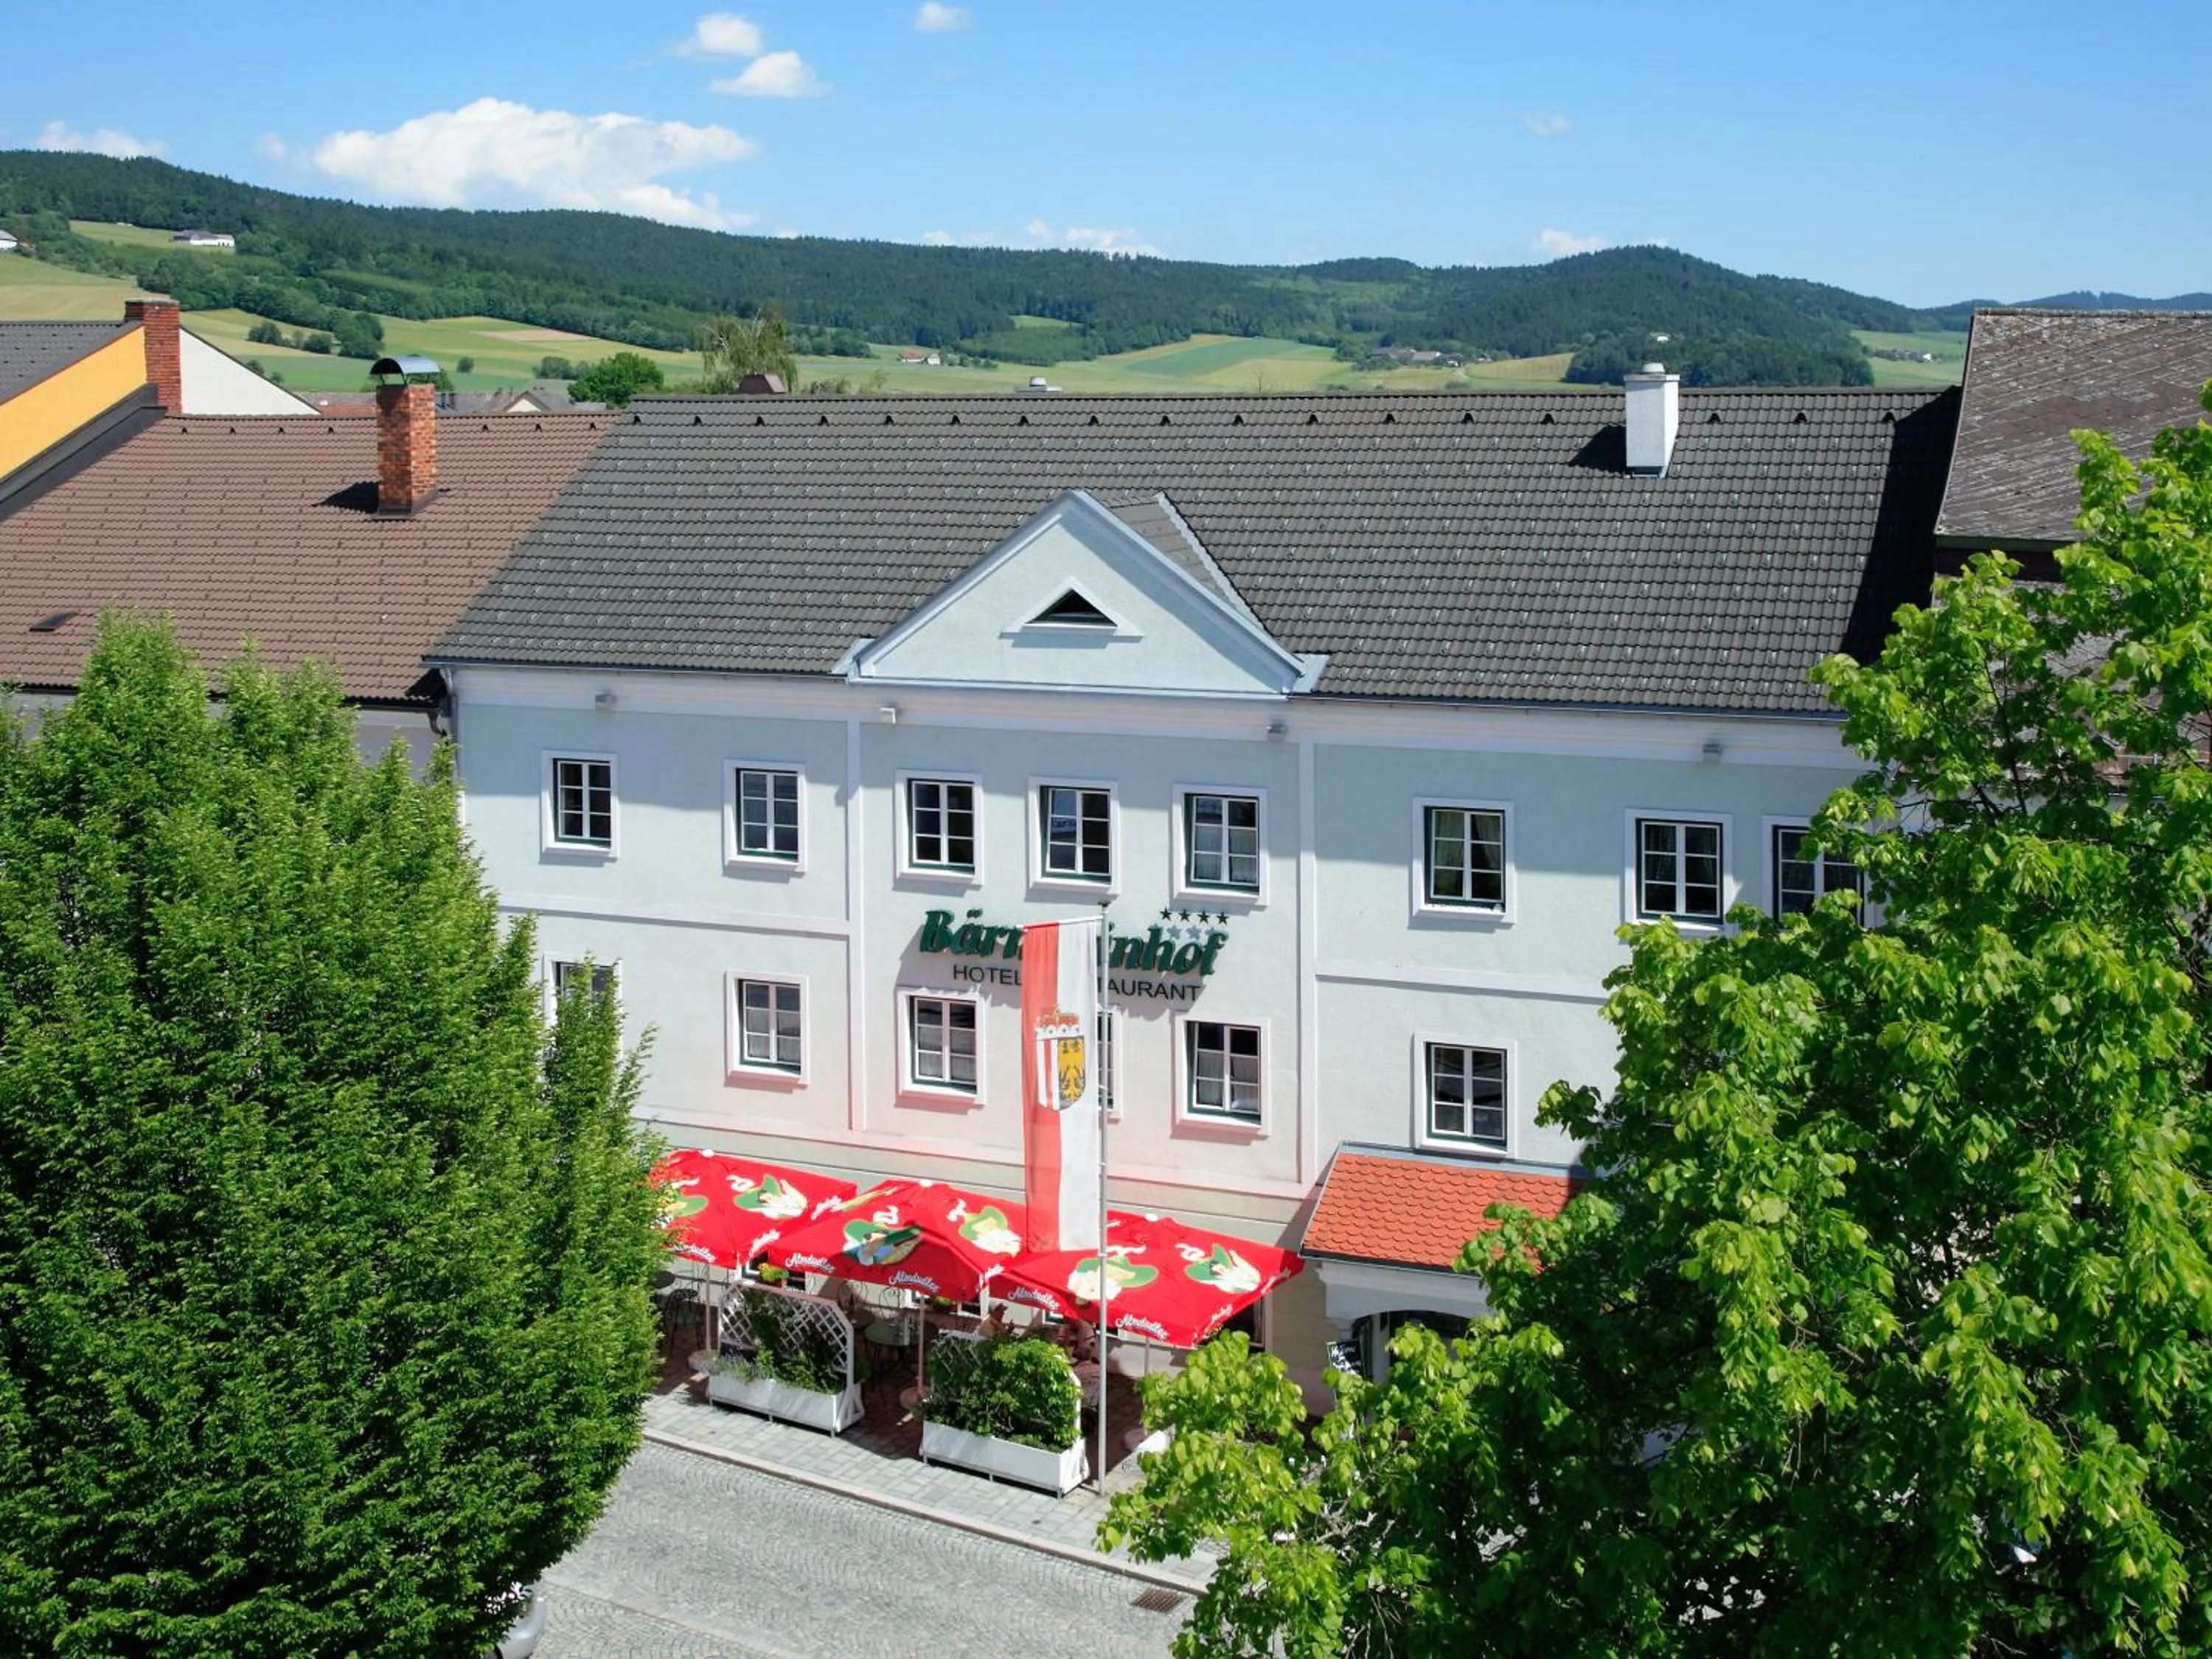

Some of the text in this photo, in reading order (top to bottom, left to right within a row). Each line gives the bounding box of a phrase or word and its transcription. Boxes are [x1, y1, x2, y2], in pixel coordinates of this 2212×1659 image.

[919, 908, 1228, 976] Bärnnhof
[953, 964, 1200, 1002] HOTEL TAURANT
[670, 1243, 716, 1263] mdudler
[888, 1270, 941, 1293] Almdudler
[1008, 1286, 1060, 1310] Almdudler
[1115, 1313, 1169, 1340] Almdudler
